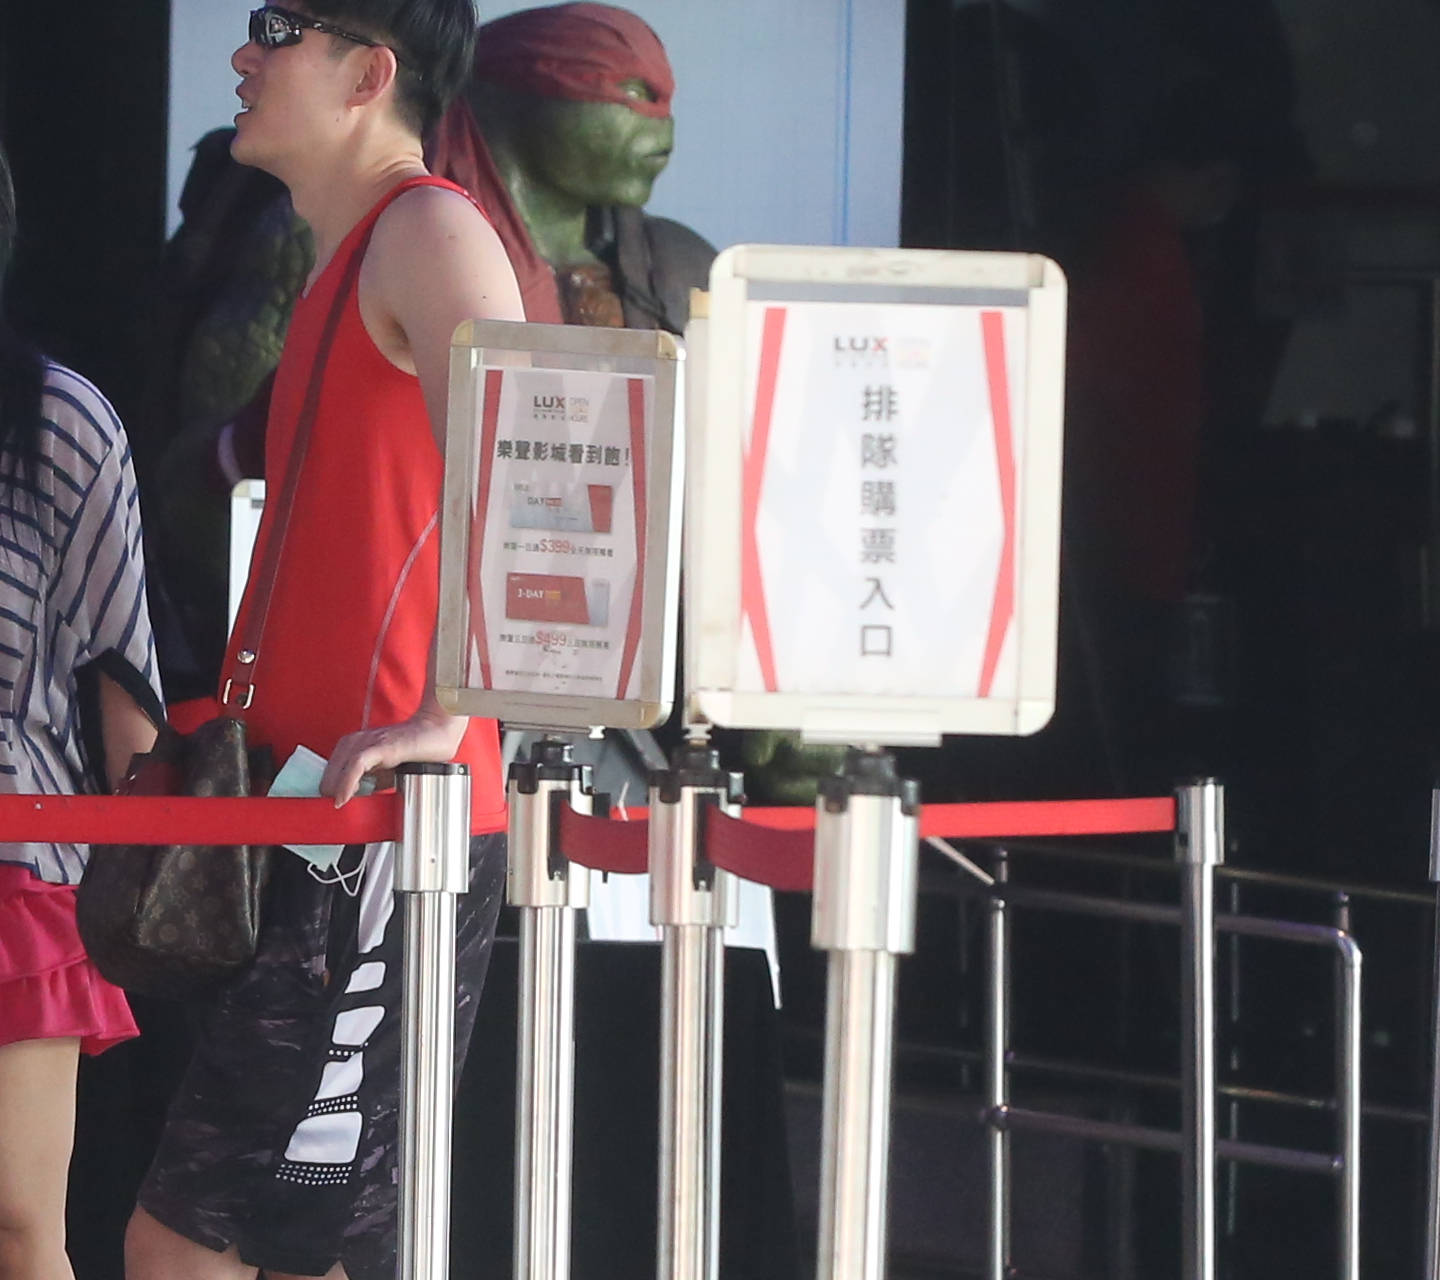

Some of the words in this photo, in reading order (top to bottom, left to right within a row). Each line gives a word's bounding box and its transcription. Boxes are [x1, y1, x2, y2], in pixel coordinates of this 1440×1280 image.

[833, 336, 889, 352] LUX
[533, 395, 566, 409] LUX
[860, 385, 900, 657] 排隊購票入口
